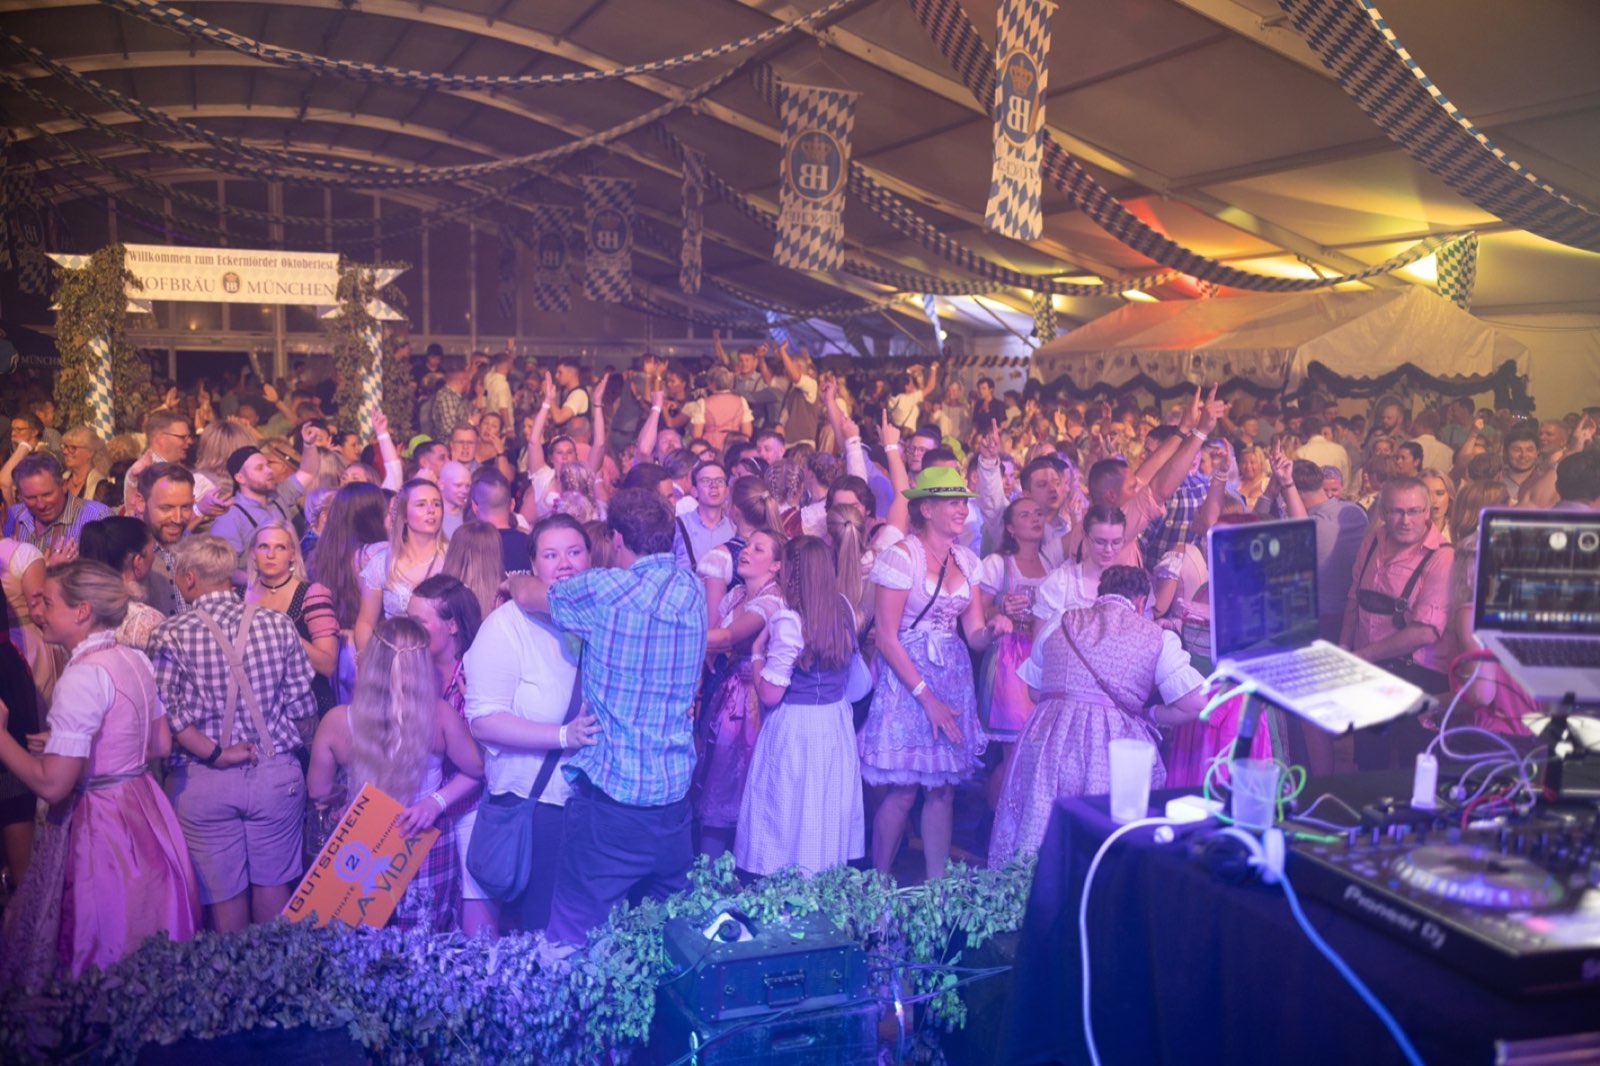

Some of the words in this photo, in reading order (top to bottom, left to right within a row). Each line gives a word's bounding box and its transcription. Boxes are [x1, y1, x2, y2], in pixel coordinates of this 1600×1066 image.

[128, 250, 192, 265] Willkommen
[194, 254, 214, 265] zum
[138, 275, 215, 293] OFBRÄU
[247, 279, 336, 296] MÜNCHEN
[288, 795, 370, 913] GUTSCHEIN
[345, 854, 361, 871] 2
[370, 836, 422, 892] VIDA
